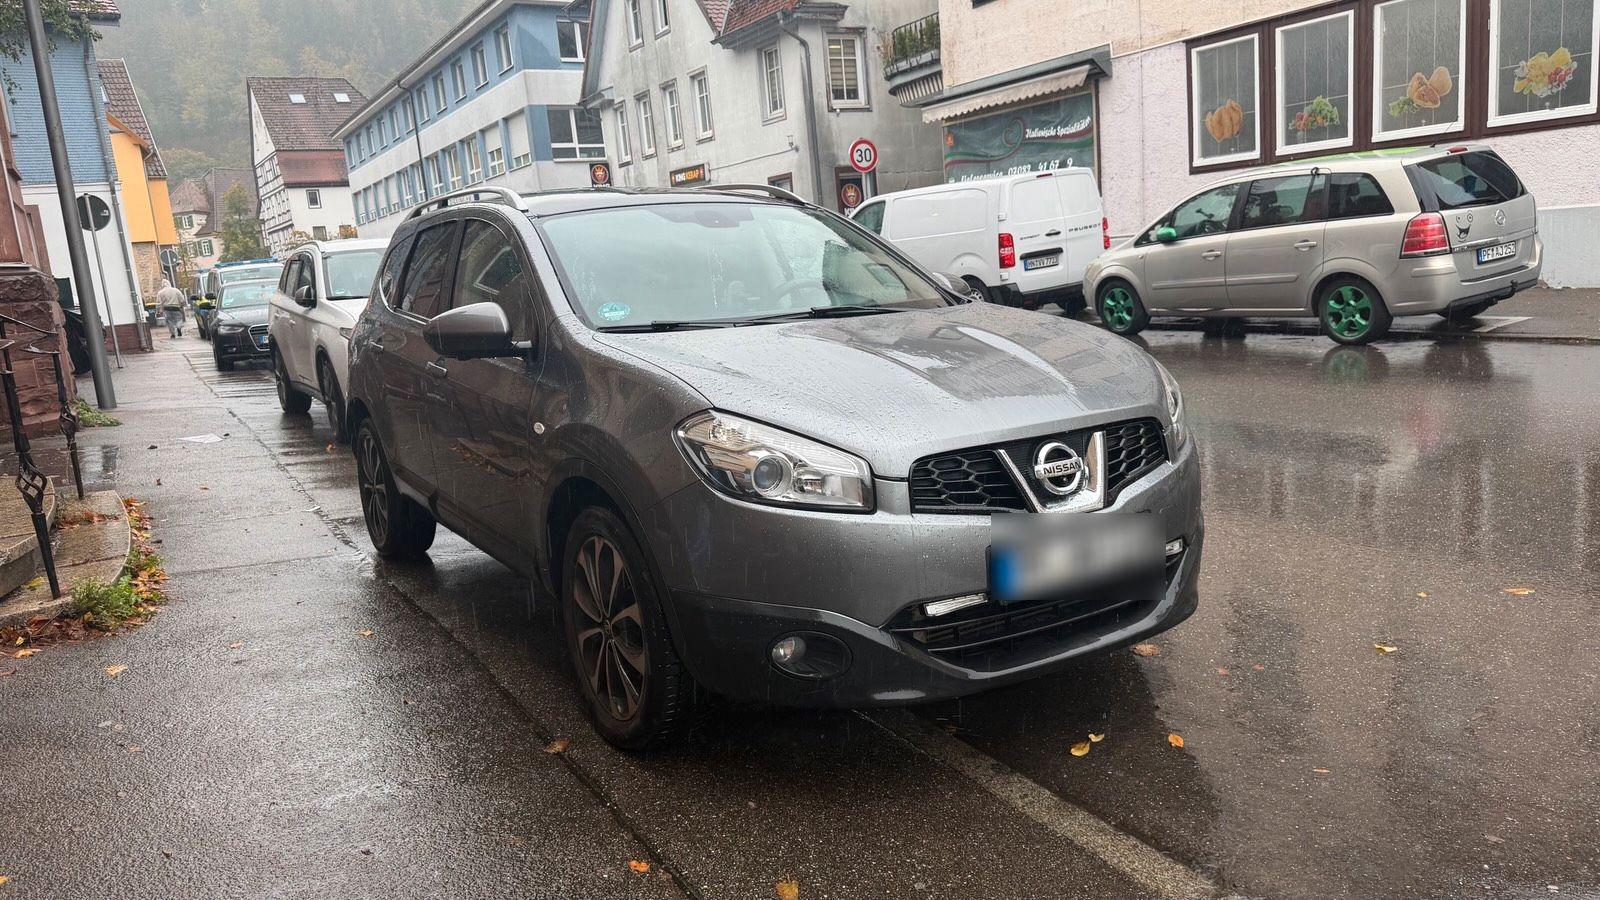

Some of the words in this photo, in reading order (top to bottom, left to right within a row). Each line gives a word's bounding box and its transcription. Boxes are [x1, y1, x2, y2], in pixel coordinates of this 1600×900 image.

[856, 148, 872, 163] 30
[1069, 223, 1101, 232] PEUGEOT
[1043, 461, 1081, 474] NISSAN
